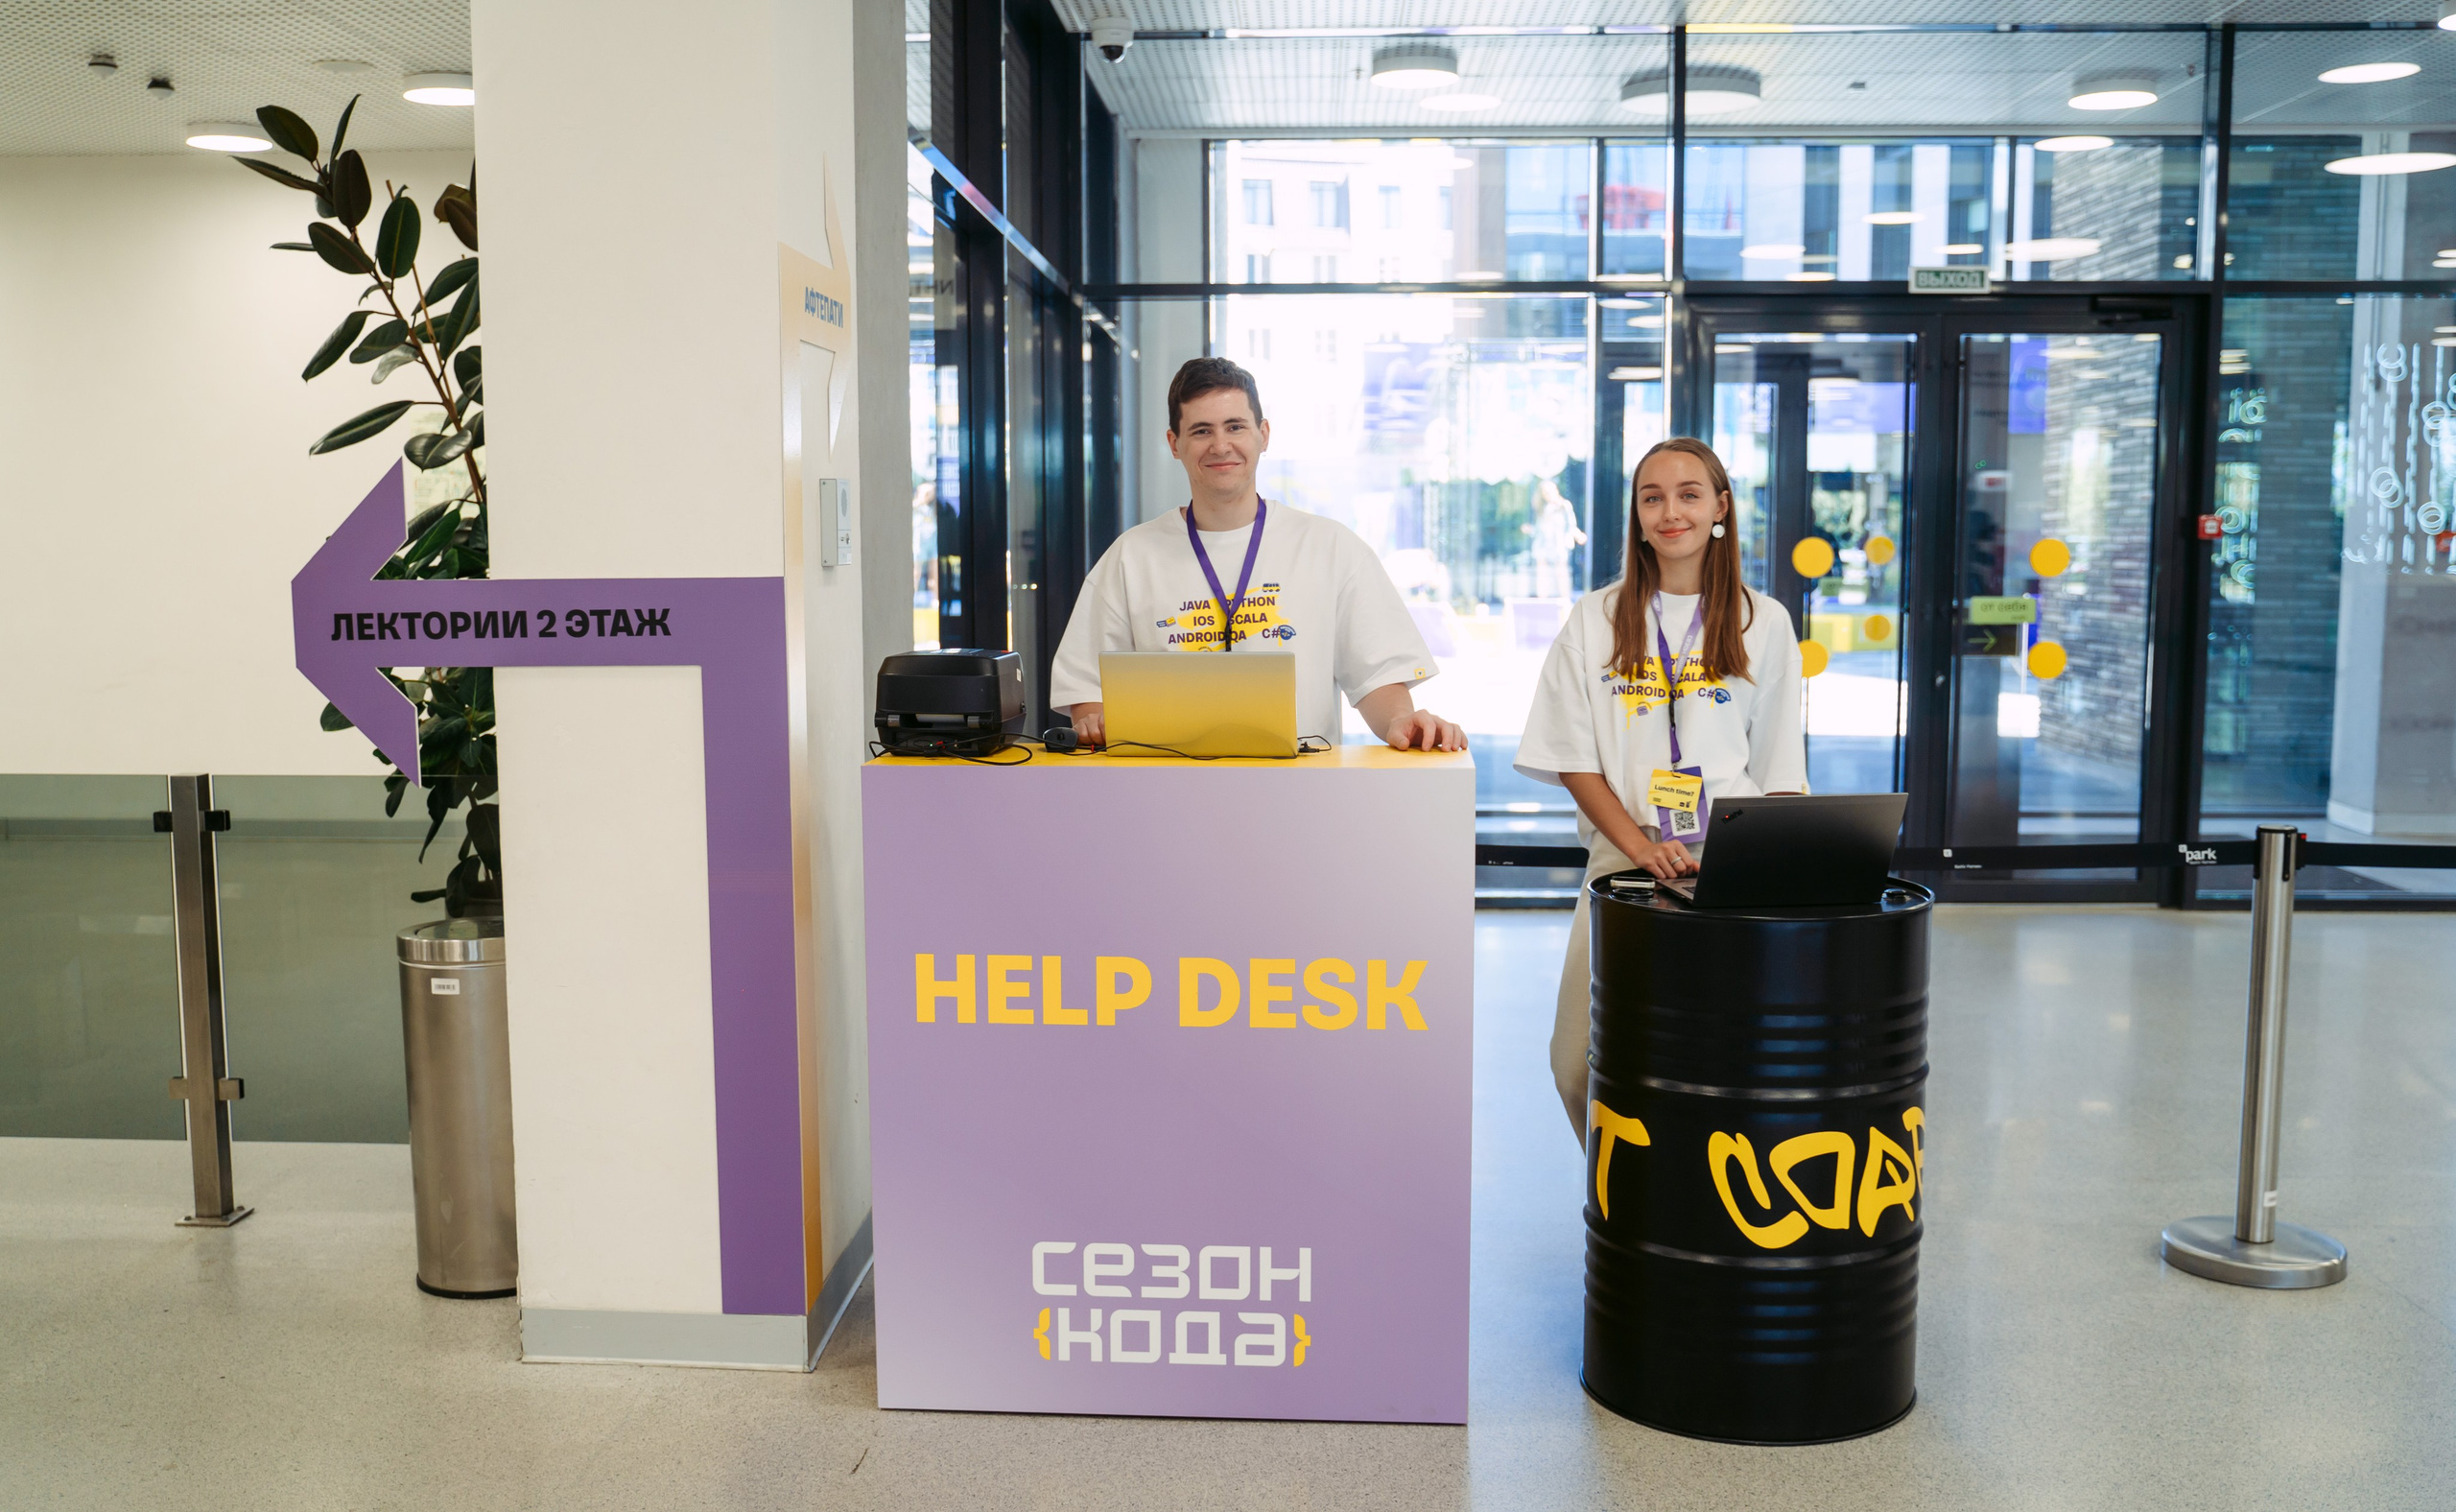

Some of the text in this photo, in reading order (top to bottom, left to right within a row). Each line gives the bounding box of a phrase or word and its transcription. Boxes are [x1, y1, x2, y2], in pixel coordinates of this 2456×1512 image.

[804, 286, 844, 329] АФТЕПАТИ
[1179, 600, 1211, 611] JAVA
[331, 608, 672, 641] ЛЕКТОРИИ 2 ЭТАЖ
[1193, 615, 1215, 626] IOS
[1168, 630, 1226, 645] ANDROID
[1230, 629, 1247, 644] QA
[1612, 684, 1665, 698] ANDROID
[1697, 687, 1715, 699] C#
[1654, 784, 1695, 797] Lunch time?
[2185, 847, 2217, 863] park
[914, 953, 1429, 1031] HELP DESK
